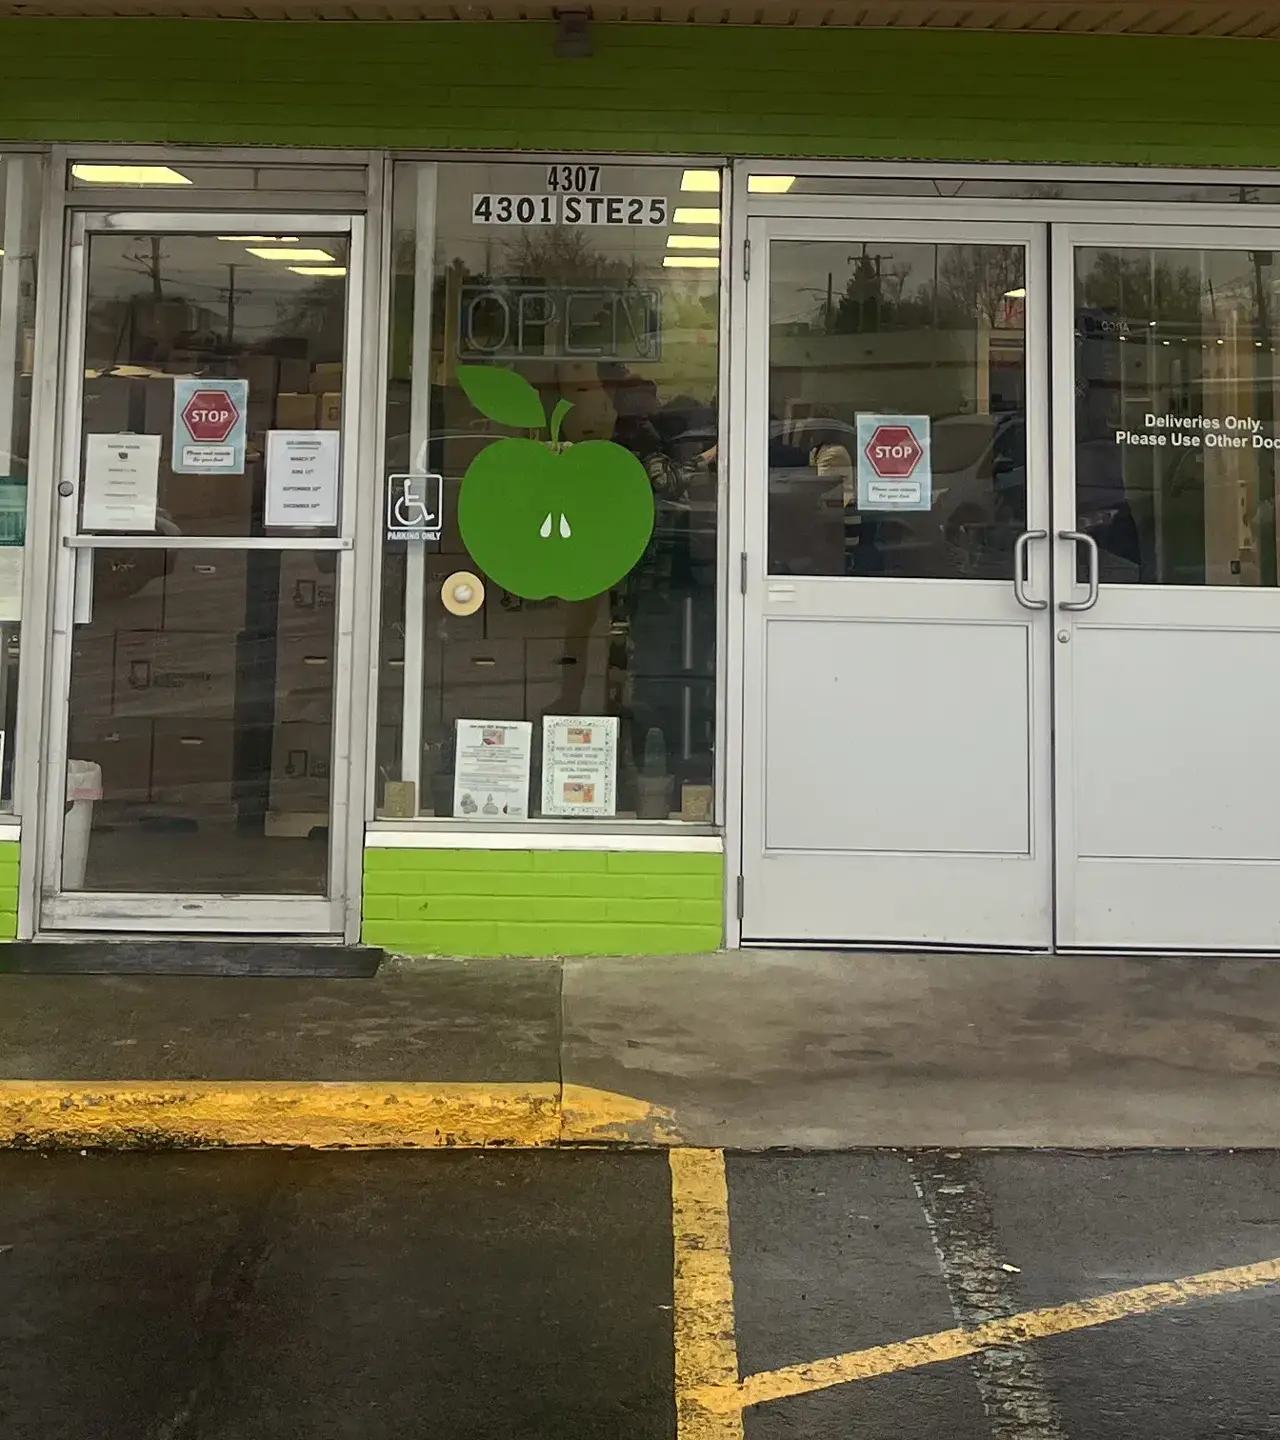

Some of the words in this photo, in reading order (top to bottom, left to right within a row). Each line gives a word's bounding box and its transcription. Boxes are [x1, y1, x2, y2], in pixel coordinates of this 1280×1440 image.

[547, 166, 601, 192] 4307
[474, 196, 552, 223] 4301
[564, 197, 666, 224] STE25
[468, 292, 651, 357] OPEN
[191, 409, 229, 423] STOP
[1144, 413, 1220, 429] Deliveries
[1224, 415, 1264, 433] Only.
[1115, 431, 1167, 446] Please
[1171, 432, 1201, 447] Use
[1204, 433, 1248, 448] Other
[875, 445, 913, 458] STOP
[387, 531, 419, 541] PARKING
[421, 531, 441, 541] ONLY
